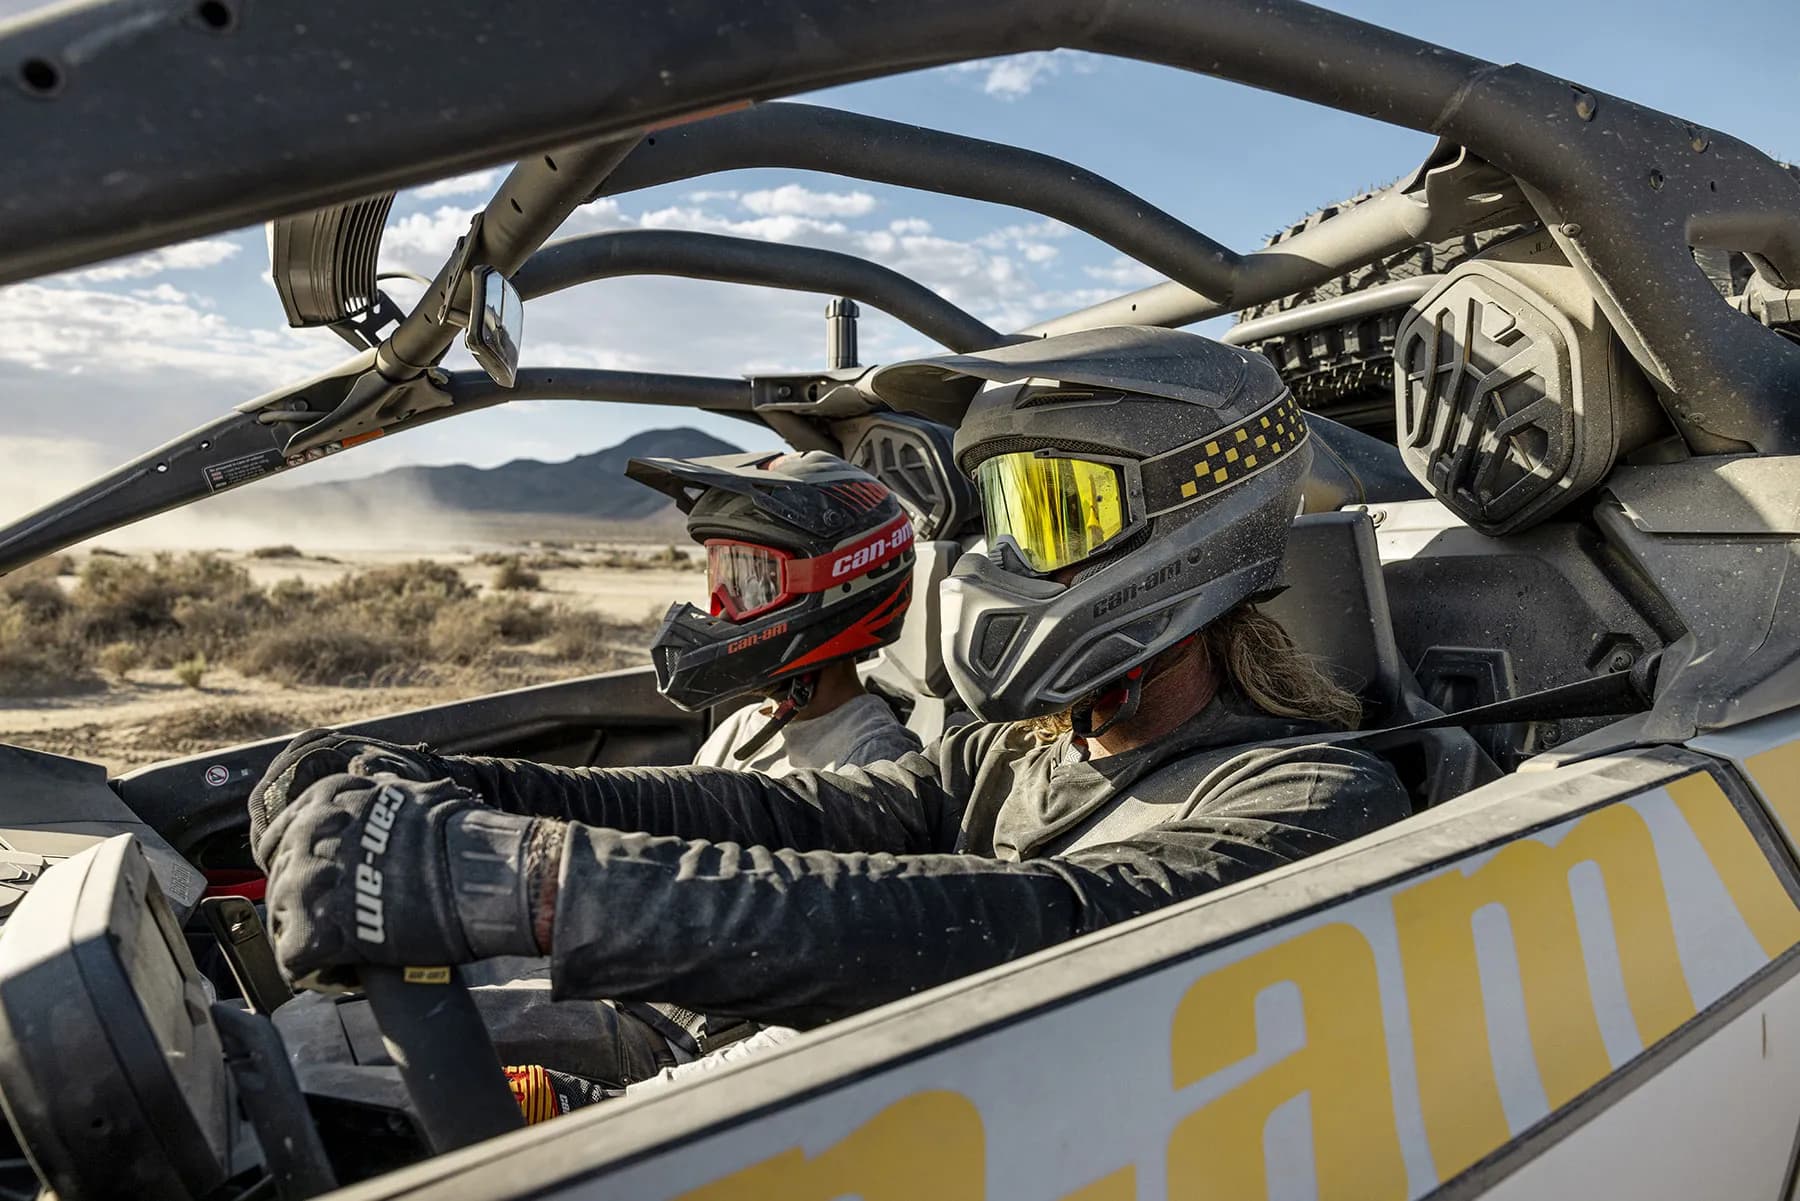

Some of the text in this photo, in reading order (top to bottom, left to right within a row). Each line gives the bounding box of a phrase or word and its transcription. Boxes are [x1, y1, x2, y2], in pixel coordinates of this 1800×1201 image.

[1093, 559, 1182, 618] can-am
[727, 622, 789, 655] can-am
[355, 785, 406, 944] can-am
